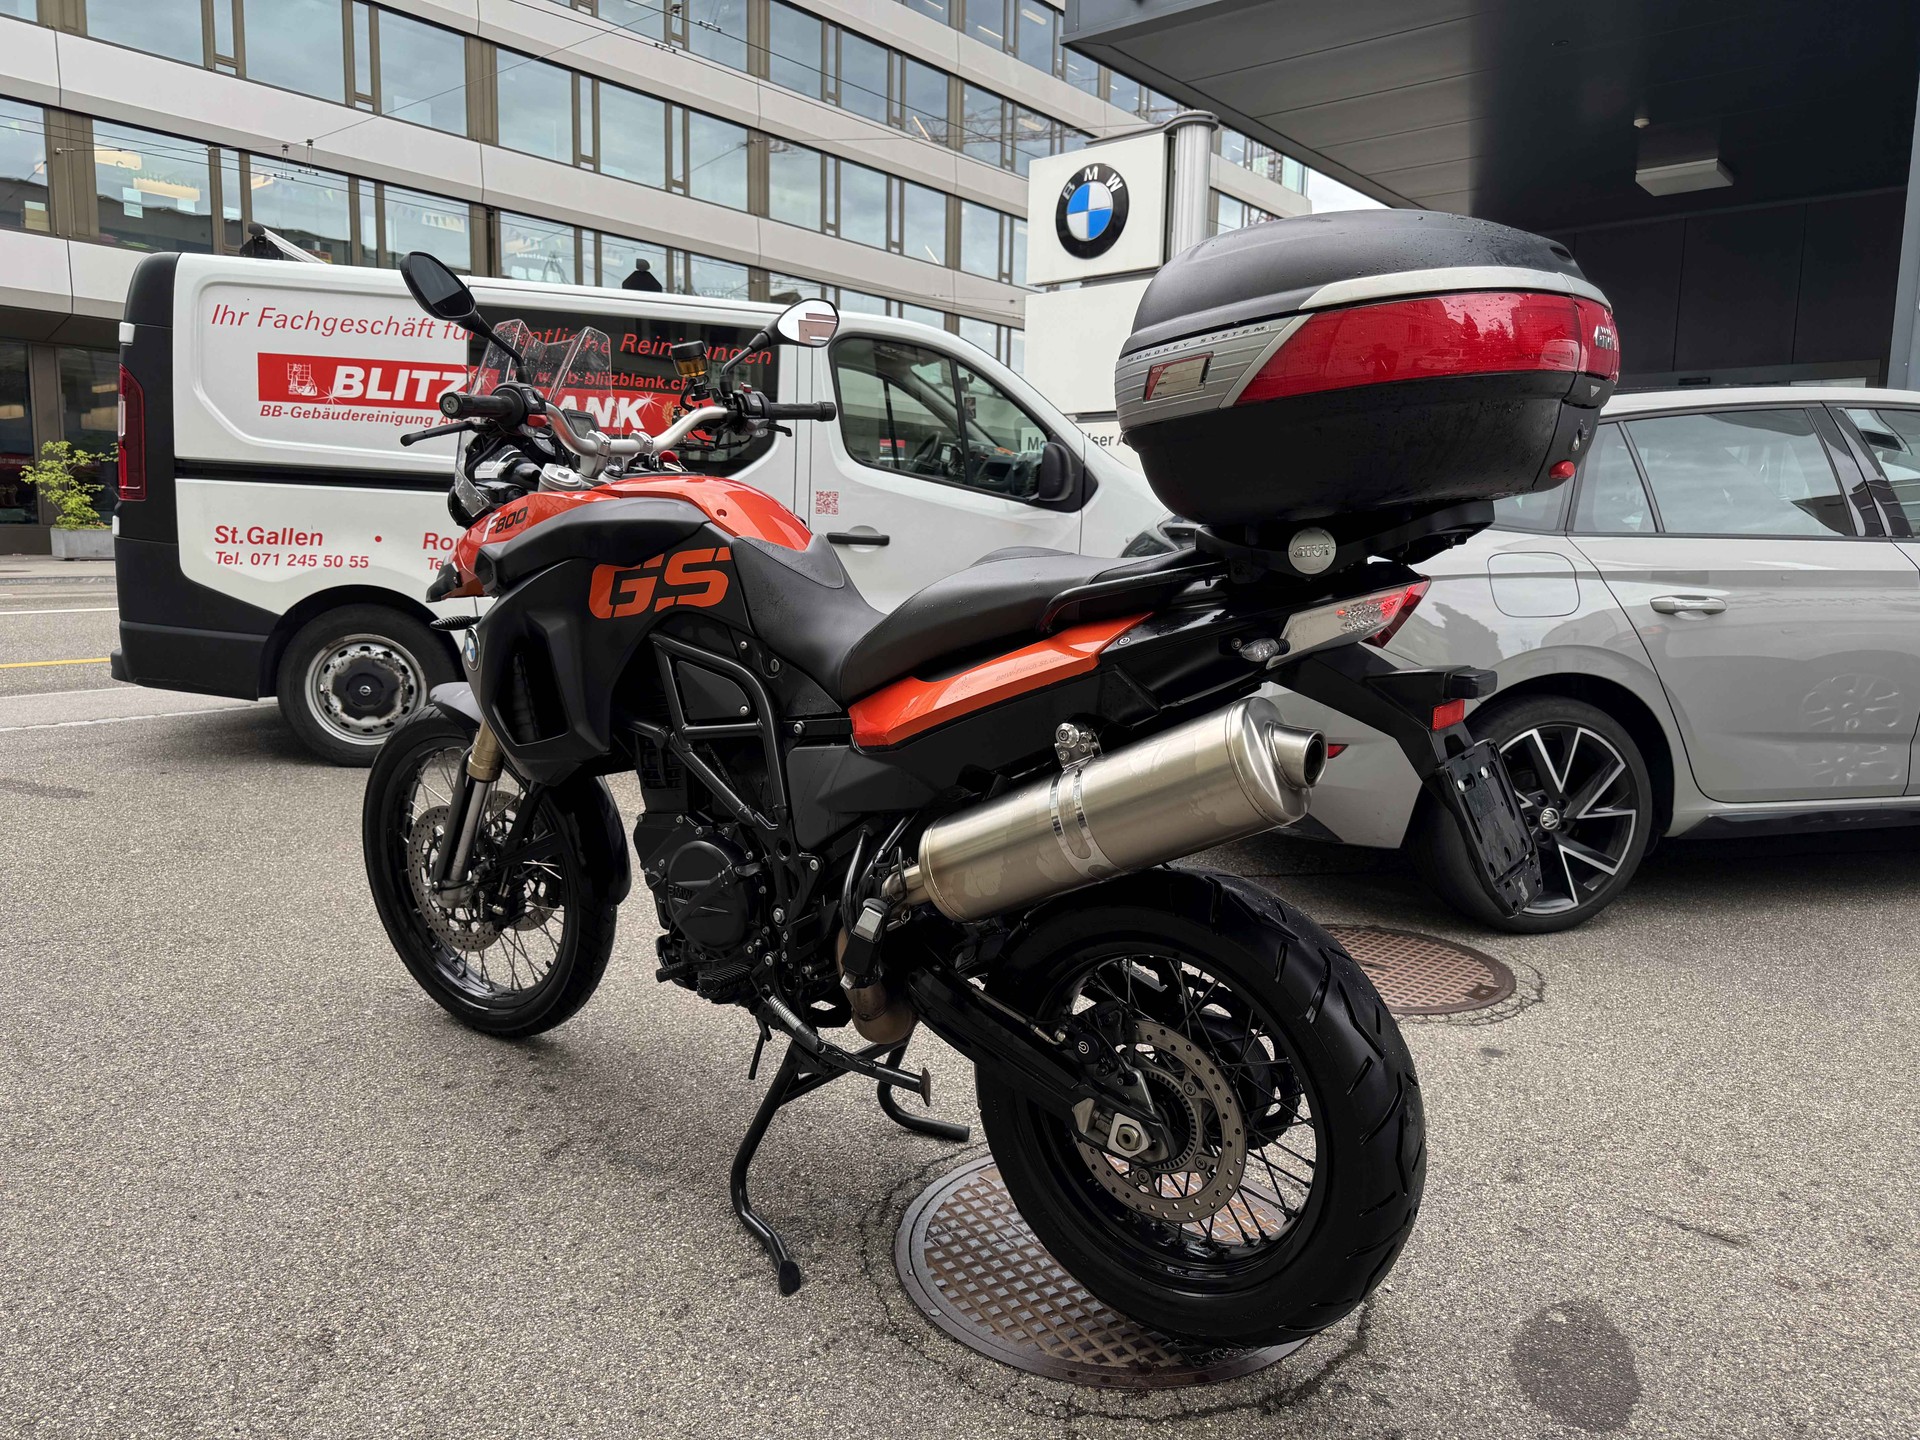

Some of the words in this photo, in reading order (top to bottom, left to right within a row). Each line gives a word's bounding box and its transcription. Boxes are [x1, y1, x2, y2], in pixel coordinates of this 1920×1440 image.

[1062, 165, 1123, 200] BMW
[211, 304, 249, 326] Ihr
[257, 307, 436, 338] Fachgeschäft
[1126, 342, 1190, 363] MONOKEY
[1200, 325, 1266, 343] SYSTEM
[332, 365, 469, 403] BLITZ
[260, 405, 433, 428] BB-Gebäudereinigung
[214, 525, 324, 546] St.Gallen
[423, 532, 459, 551] Ro
[482, 506, 528, 543] F800
[215, 552, 243, 565] Tel.
[250, 553, 279, 566] 071
[287, 554, 317, 567] 245
[323, 555, 344, 568] 50
[349, 556, 369, 568] 55
[1293, 543, 1330, 557] GIVI
[588, 546, 732, 620] GS
